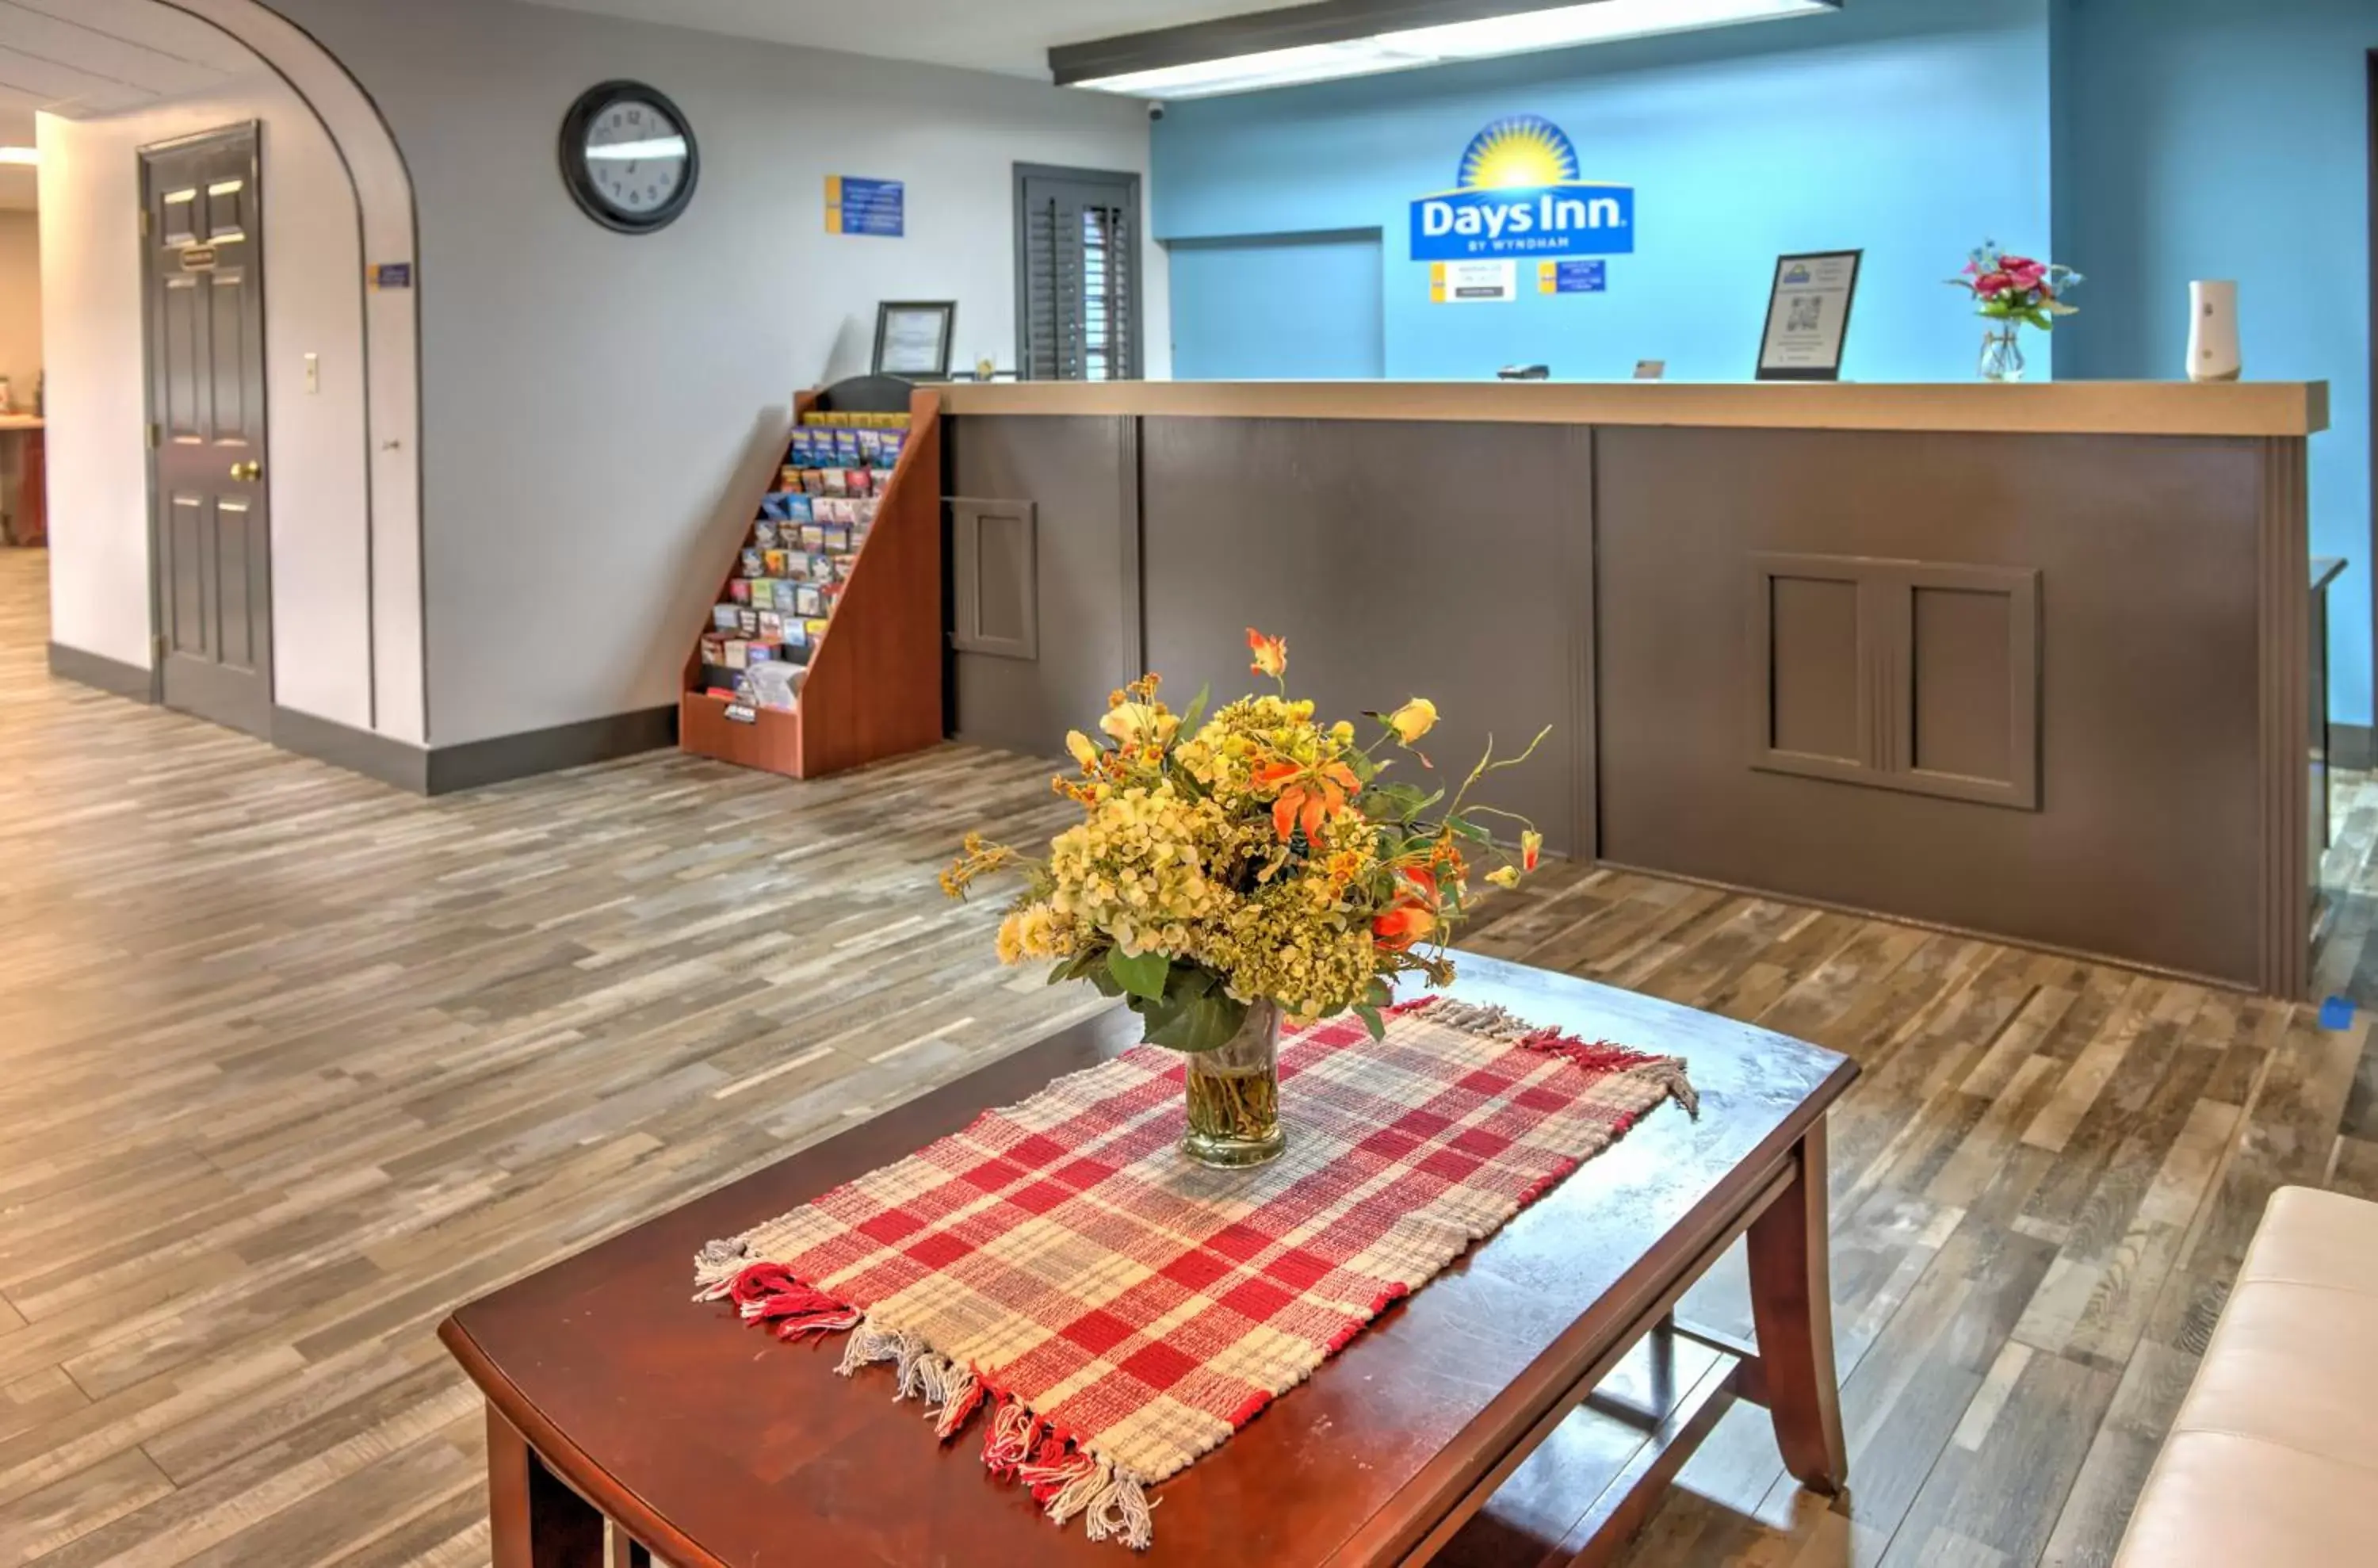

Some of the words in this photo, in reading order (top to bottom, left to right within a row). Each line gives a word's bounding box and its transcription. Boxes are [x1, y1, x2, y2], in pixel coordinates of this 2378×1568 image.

[627, 110, 640, 125] 12
[629, 189, 640, 205] 6
[1422, 200, 1534, 239] Days
[1540, 194, 1620, 231] Inn
[1468, 240, 1486, 252] BY
[1493, 236, 1569, 251] WYNDHAM
